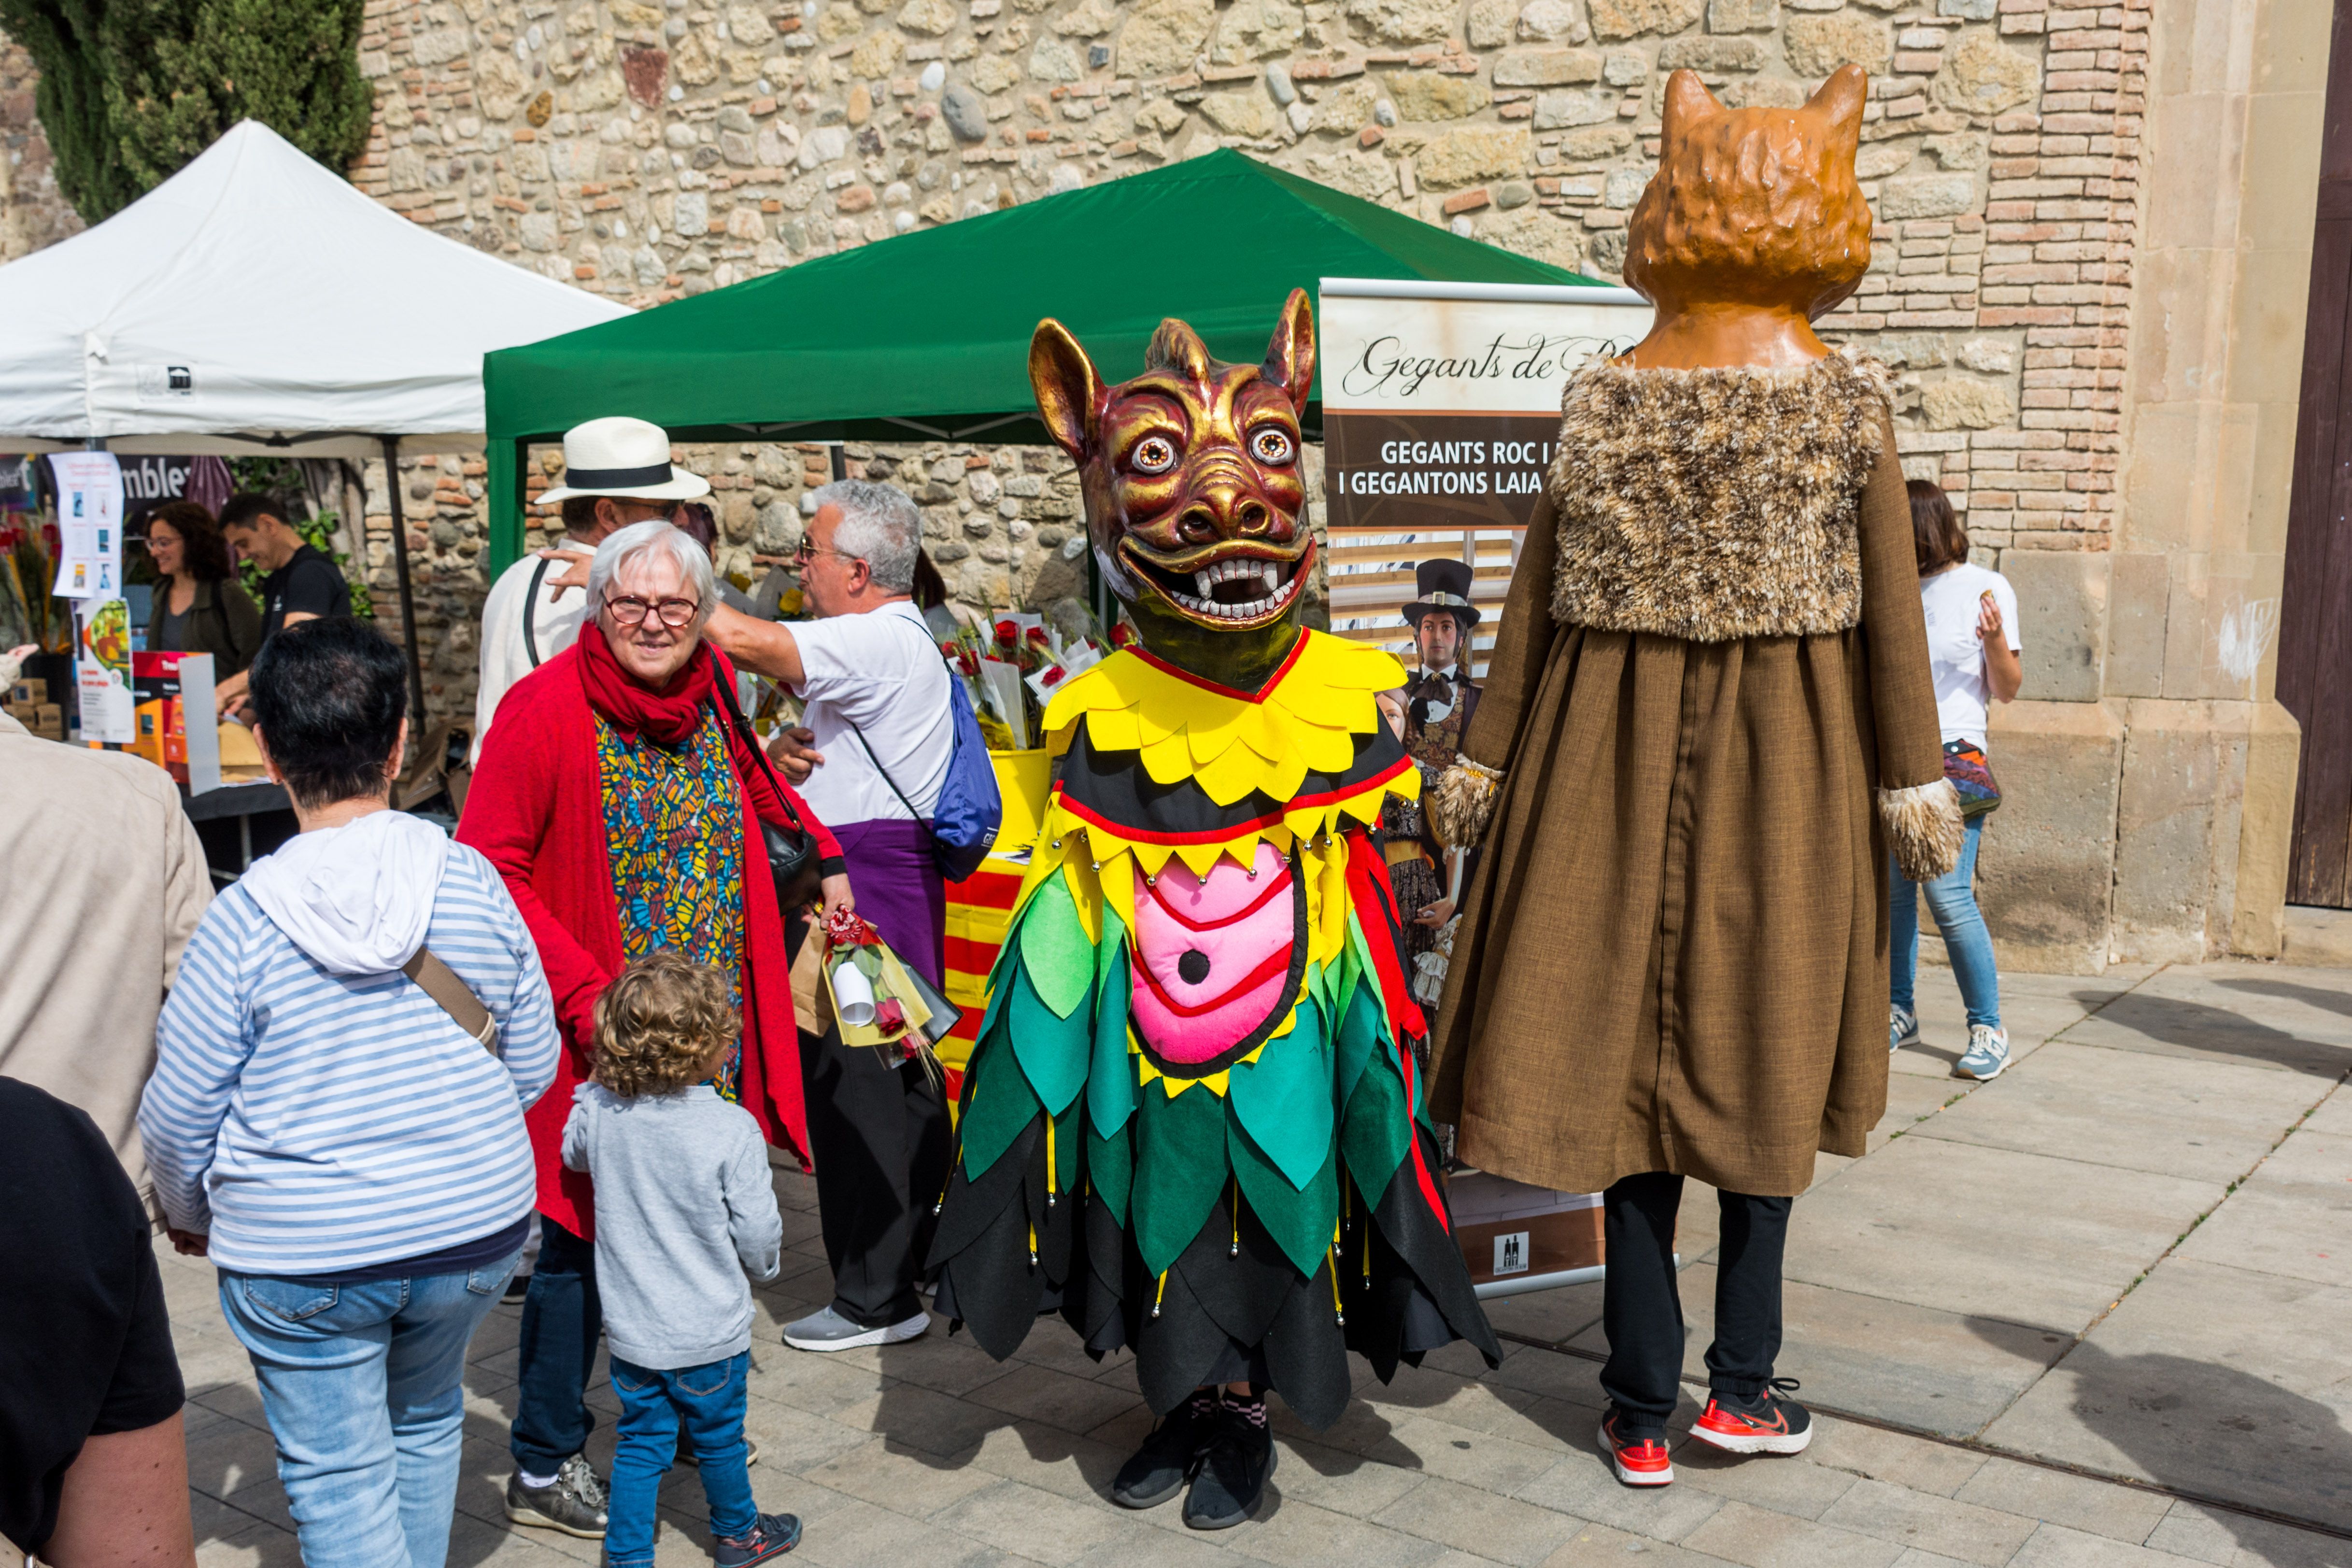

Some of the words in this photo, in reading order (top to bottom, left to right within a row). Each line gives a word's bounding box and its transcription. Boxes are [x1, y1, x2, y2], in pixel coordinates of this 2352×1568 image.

[1343, 333, 1505, 398] Gegants
[1513, 333, 1554, 379] de
[1381, 441, 1485, 465] GEGANTS
[1493, 442, 1536, 465] ROC
[1543, 442, 1548, 464] I
[1339, 472, 1345, 494] I
[1351, 471, 1488, 494] GEGANTONS
[1495, 472, 1544, 494] LAIA
